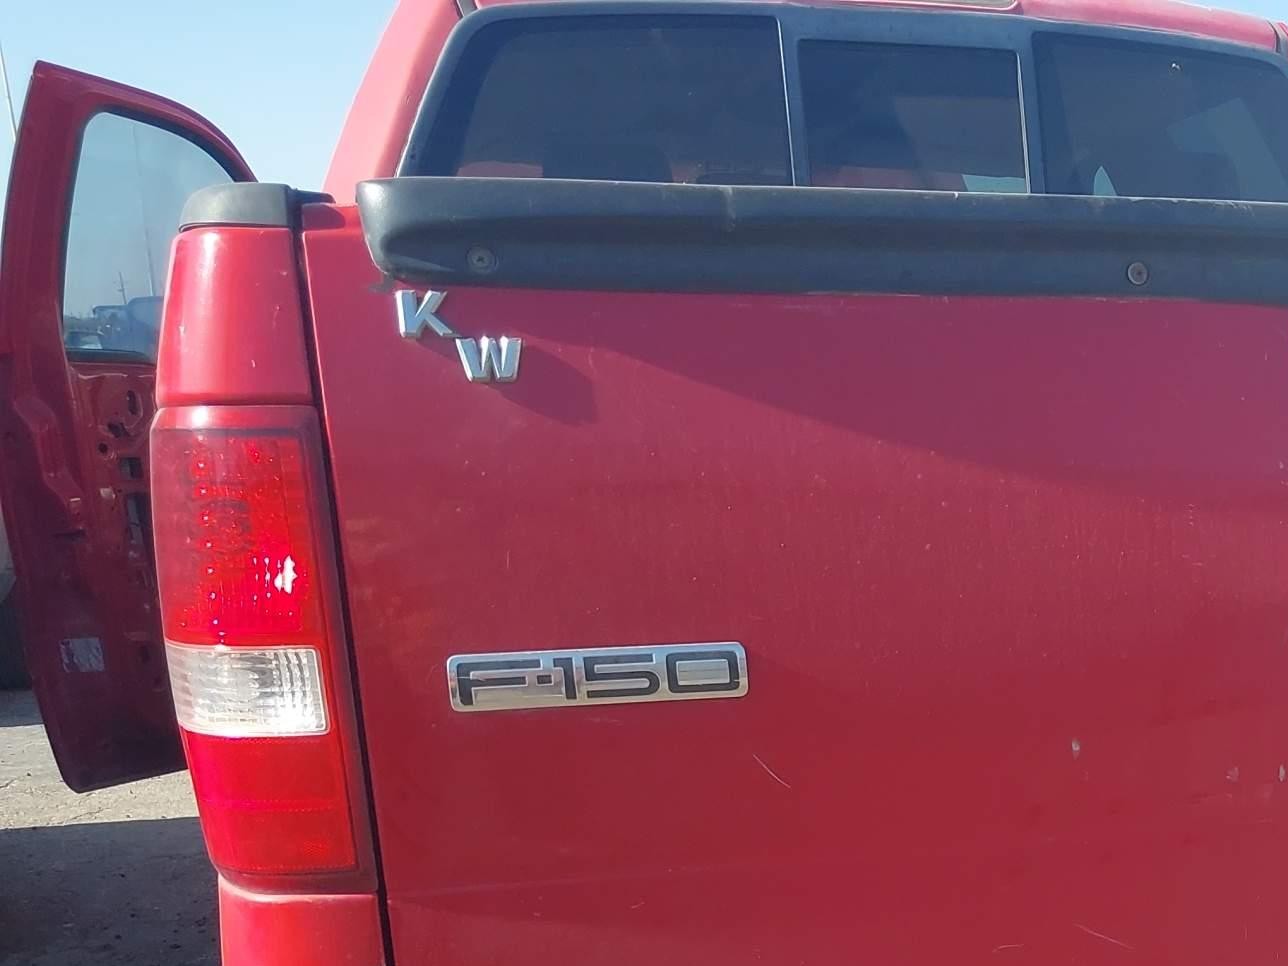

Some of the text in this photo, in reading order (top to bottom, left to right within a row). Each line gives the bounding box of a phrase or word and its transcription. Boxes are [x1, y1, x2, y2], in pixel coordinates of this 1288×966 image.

[394, 289, 453, 338] K
[455, 335, 522, 382] W
[456, 650, 741, 706] F-150
